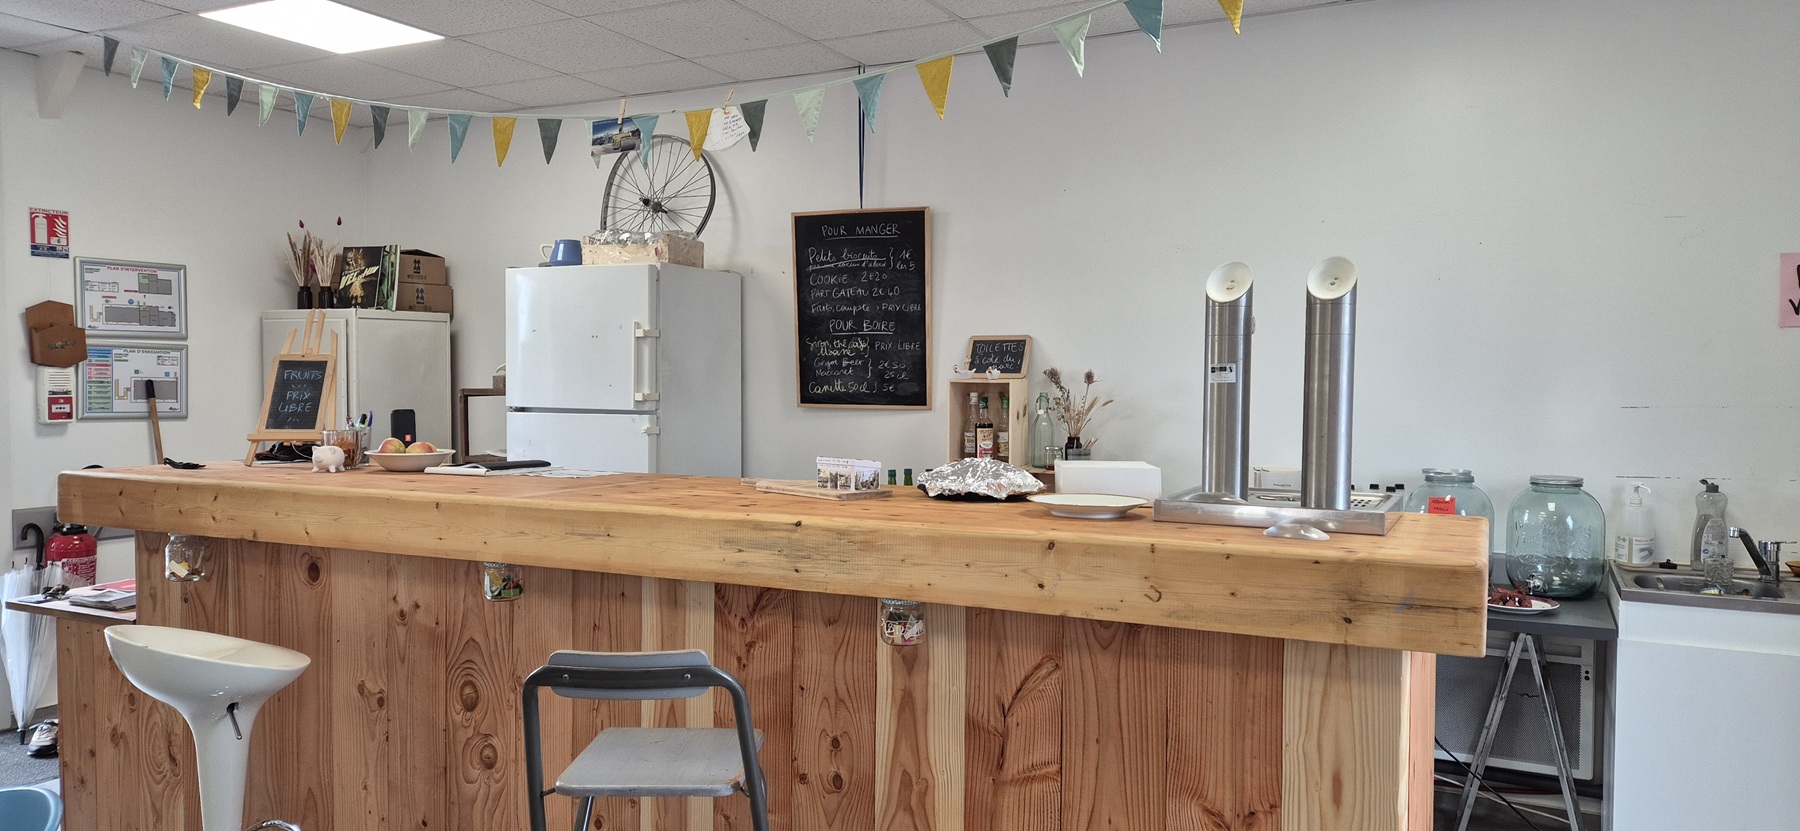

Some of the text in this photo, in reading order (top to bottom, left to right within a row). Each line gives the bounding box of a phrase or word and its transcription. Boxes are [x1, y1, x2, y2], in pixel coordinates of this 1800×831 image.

[822, 223, 901, 237] POUR MANGER
[808, 247, 837, 264] Petits
[829, 319, 896, 332] POUR BOIRE
[874, 341, 892, 351] PRIX
[897, 341, 921, 351] LIBRE
[975, 341, 1025, 354] TOILETTES
[284, 369, 323, 380] FRUITS
[278, 402, 313, 413] LIBRE
